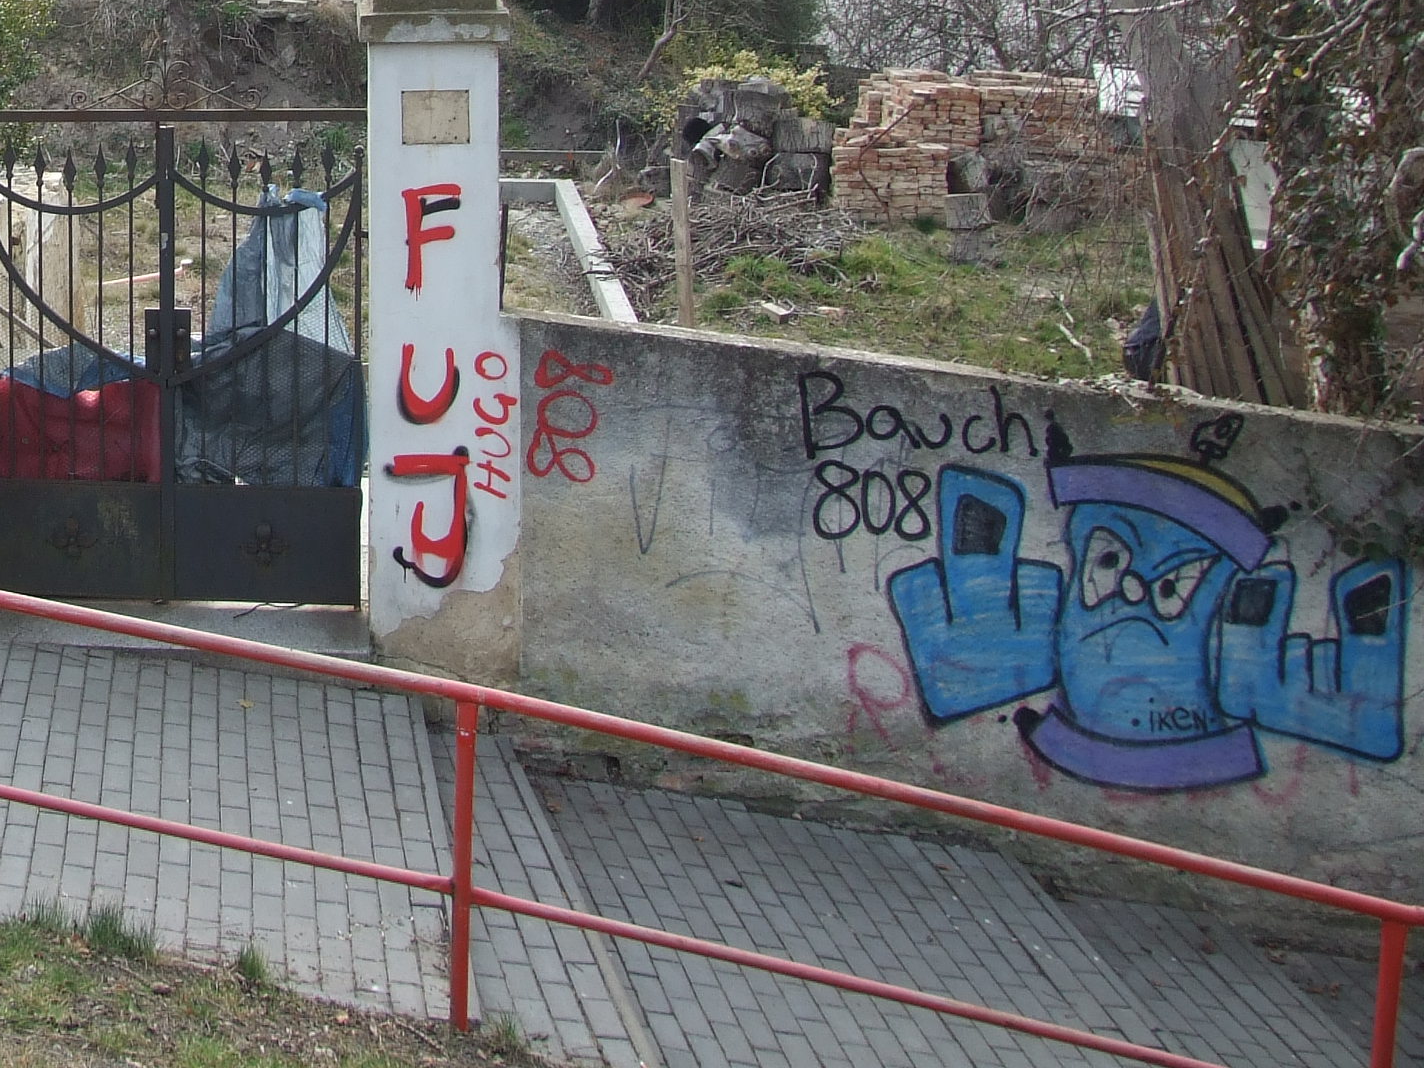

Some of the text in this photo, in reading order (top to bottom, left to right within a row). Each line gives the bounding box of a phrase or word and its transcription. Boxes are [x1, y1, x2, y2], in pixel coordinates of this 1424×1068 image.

[473, 350, 518, 500] HUGO
[526, 349, 614, 483] 808
[798, 371, 1040, 460] Bauch
[812, 459, 932, 540] 808
